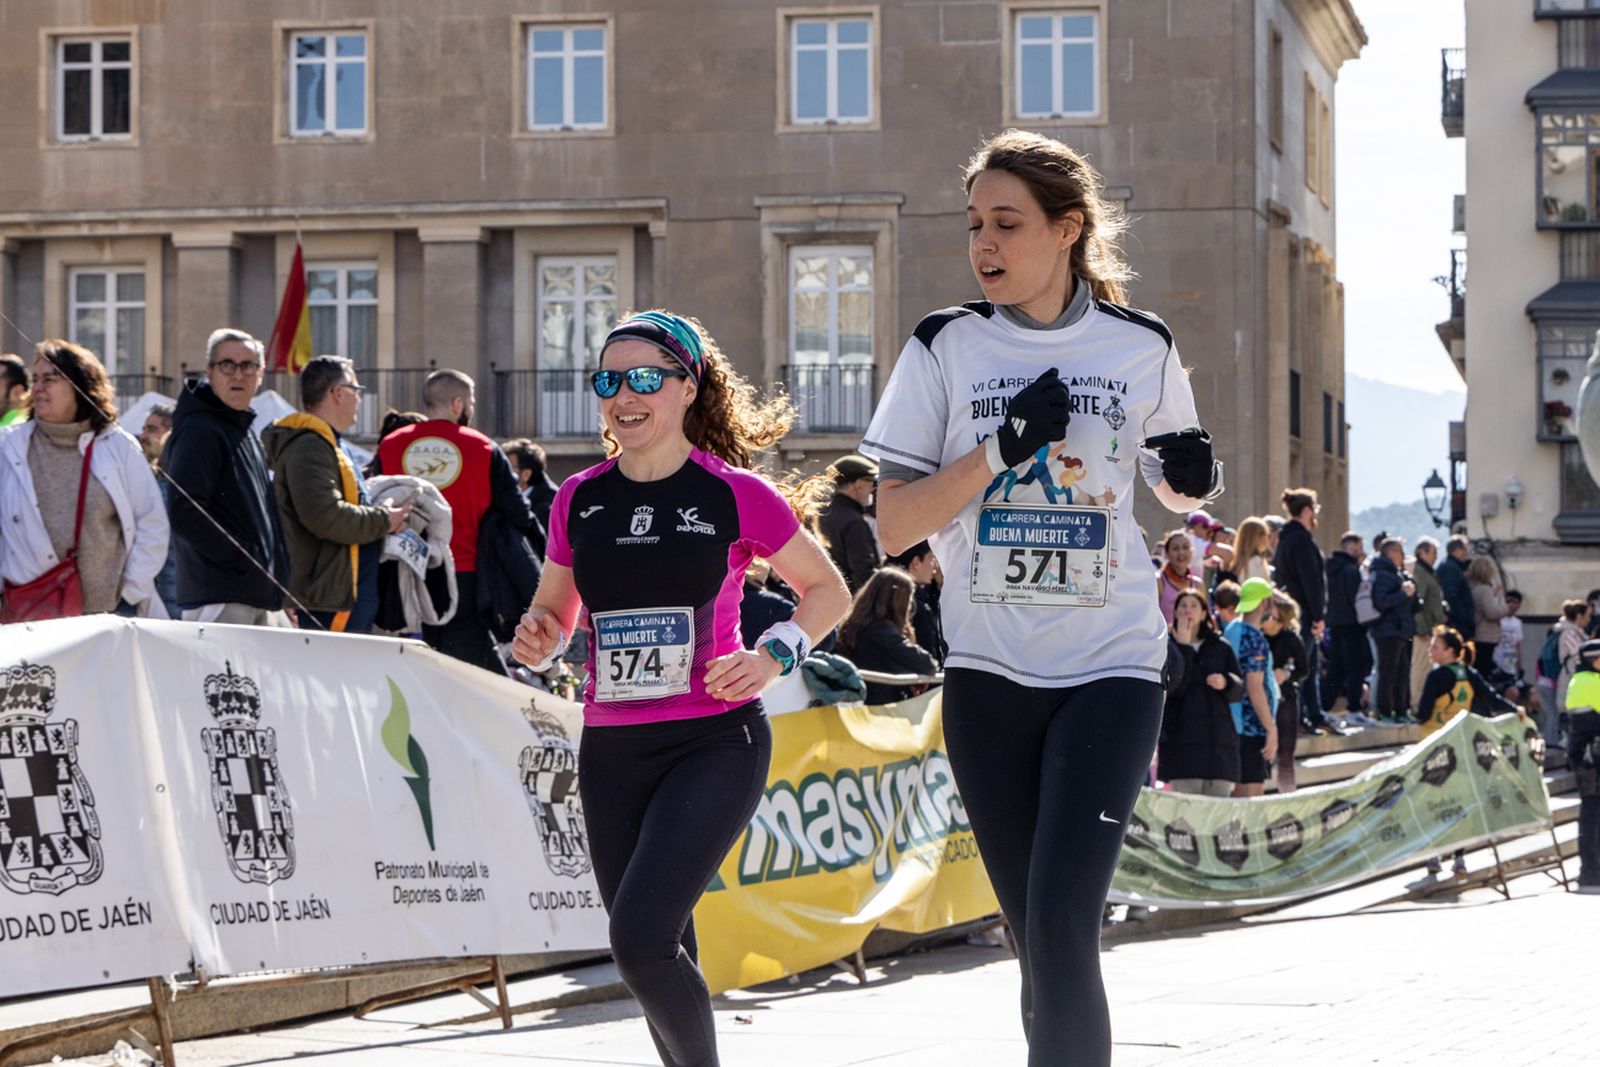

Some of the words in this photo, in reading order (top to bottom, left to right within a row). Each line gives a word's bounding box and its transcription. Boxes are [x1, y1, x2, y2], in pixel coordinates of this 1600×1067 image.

[972, 382, 984, 393] VI
[988, 377, 1035, 390] CARRE
[971, 395, 1011, 420] BUEN
[1071, 394, 1100, 416] RTE
[999, 513, 1041, 524] CARRERA
[1043, 515, 1092, 525] CAMINATA
[989, 527, 1021, 542] BUENA
[1025, 529, 1069, 544] MUERTE
[1005, 549, 1067, 585] 571
[634, 616, 676, 627] CAMINATA
[622, 630, 657, 644] MUERTE
[610, 648, 664, 682] 574
[739, 749, 971, 886] masyma
[374, 861, 426, 880] Patronato
[428, 860, 477, 882] Municipal
[393, 885, 442, 908] Deportes
[529, 890, 576, 911] CIUDAD
[579, 889, 594, 908] DE
[60, 908, 93, 934] DE
[98, 896, 152, 929] JAÉN
[210, 900, 270, 925] CIUDAD
[272, 900, 291, 921] DE
[294, 892, 331, 920] JAÉN
